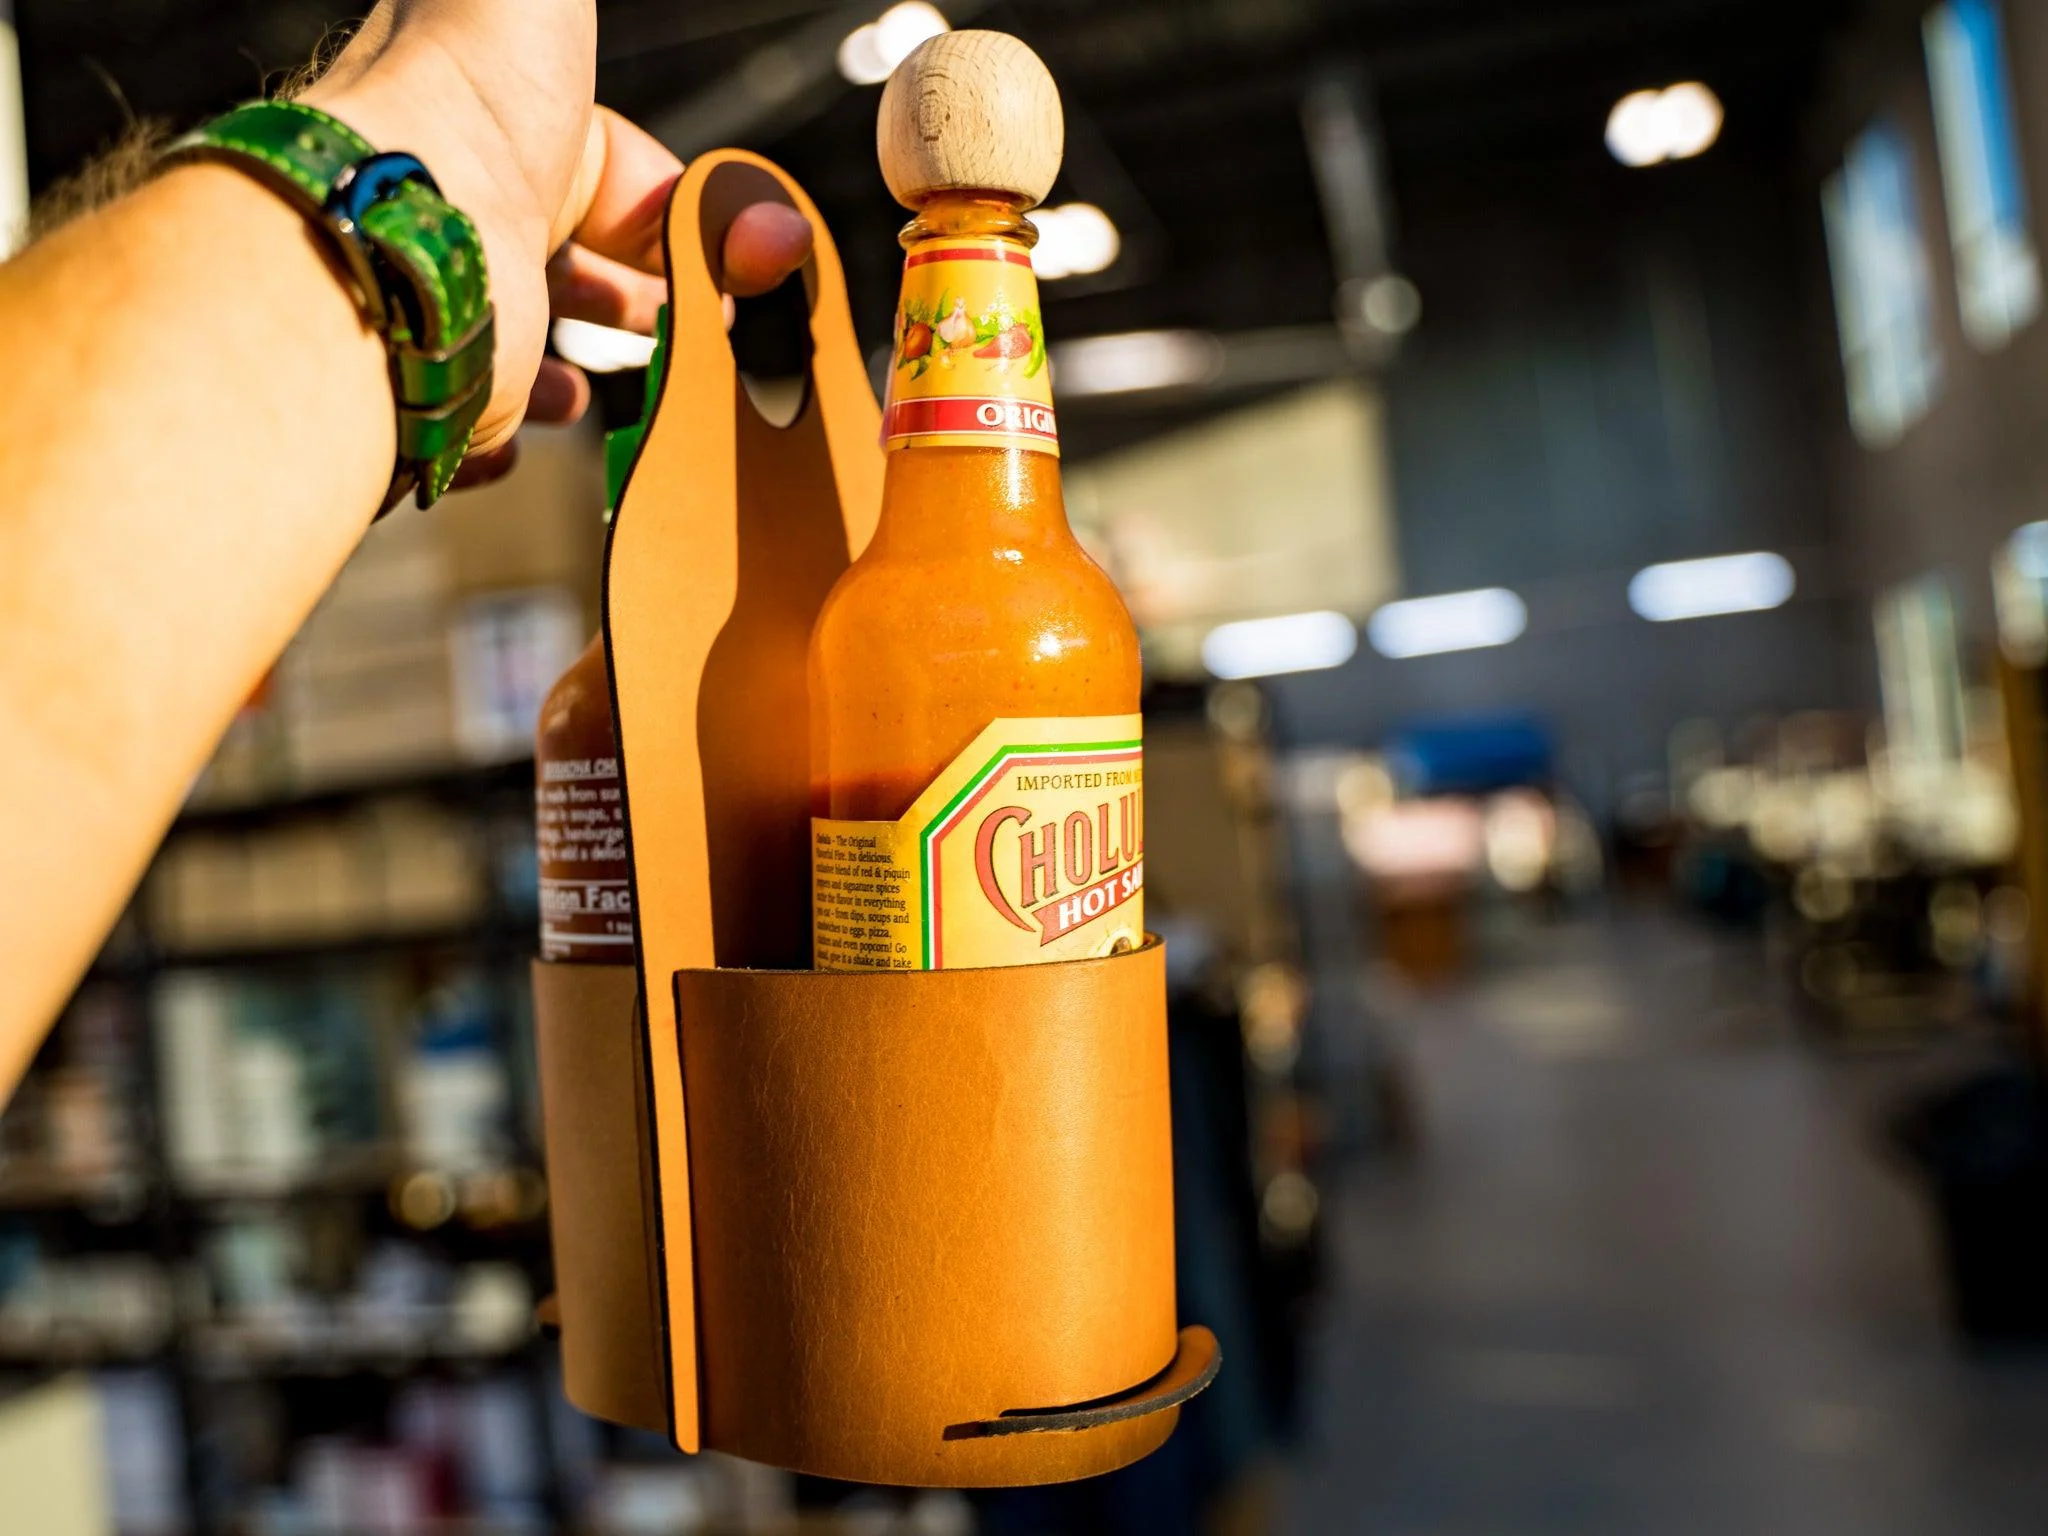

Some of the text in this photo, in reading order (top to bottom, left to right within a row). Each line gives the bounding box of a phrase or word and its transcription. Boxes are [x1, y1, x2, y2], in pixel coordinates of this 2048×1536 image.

[1017, 772, 1102, 791] IMPORTED
[1106, 769, 1132, 787] FROM
[848, 836, 877, 850] Original
[858, 852, 894, 865] delicious,
[853, 864, 860, 877] of
[861, 866, 873, 878] red
[875, 866, 882, 878] &
[884, 867, 911, 882] piquin
[876, 883, 901, 896] spices
[863, 897, 906, 912] everything
[1059, 880, 1118, 930] HOT
[850, 909, 866, 923] dips,
[868, 913, 892, 926] soups
[893, 913, 910, 924] and
[850, 927, 867, 939] eggs,
[868, 927, 892, 940] pizza,
[860, 942, 893, 954] popcorn!
[895, 942, 908, 954] Go
[853, 953, 874, 967] shake
[876, 956, 891, 968] and
[893, 957, 912, 969] take
